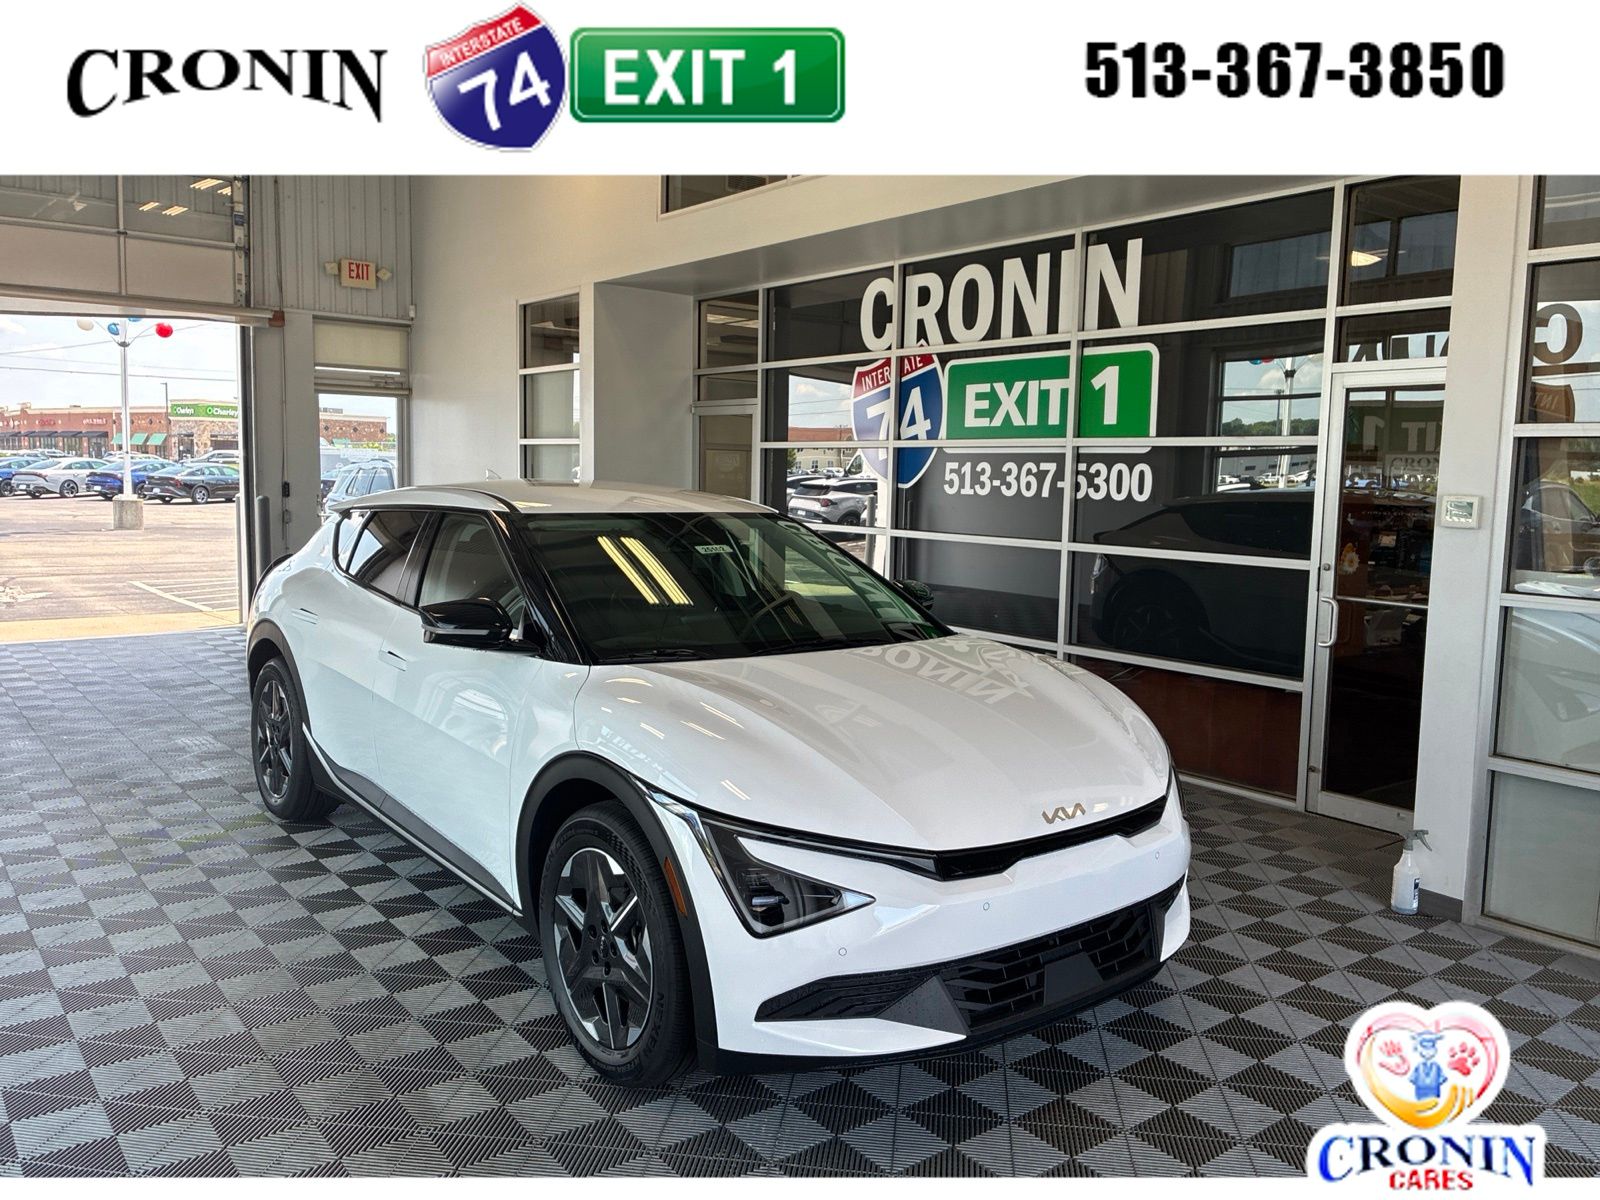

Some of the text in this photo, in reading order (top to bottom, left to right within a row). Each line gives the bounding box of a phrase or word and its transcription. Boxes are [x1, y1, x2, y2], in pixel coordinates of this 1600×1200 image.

[348, 261, 370, 281] EXIT
[860, 238, 1143, 351] CRONIN
[866, 386, 931, 461] 74
[964, 366, 1120, 427] EXIT 1
[944, 461, 1152, 502] 513-367-5300
